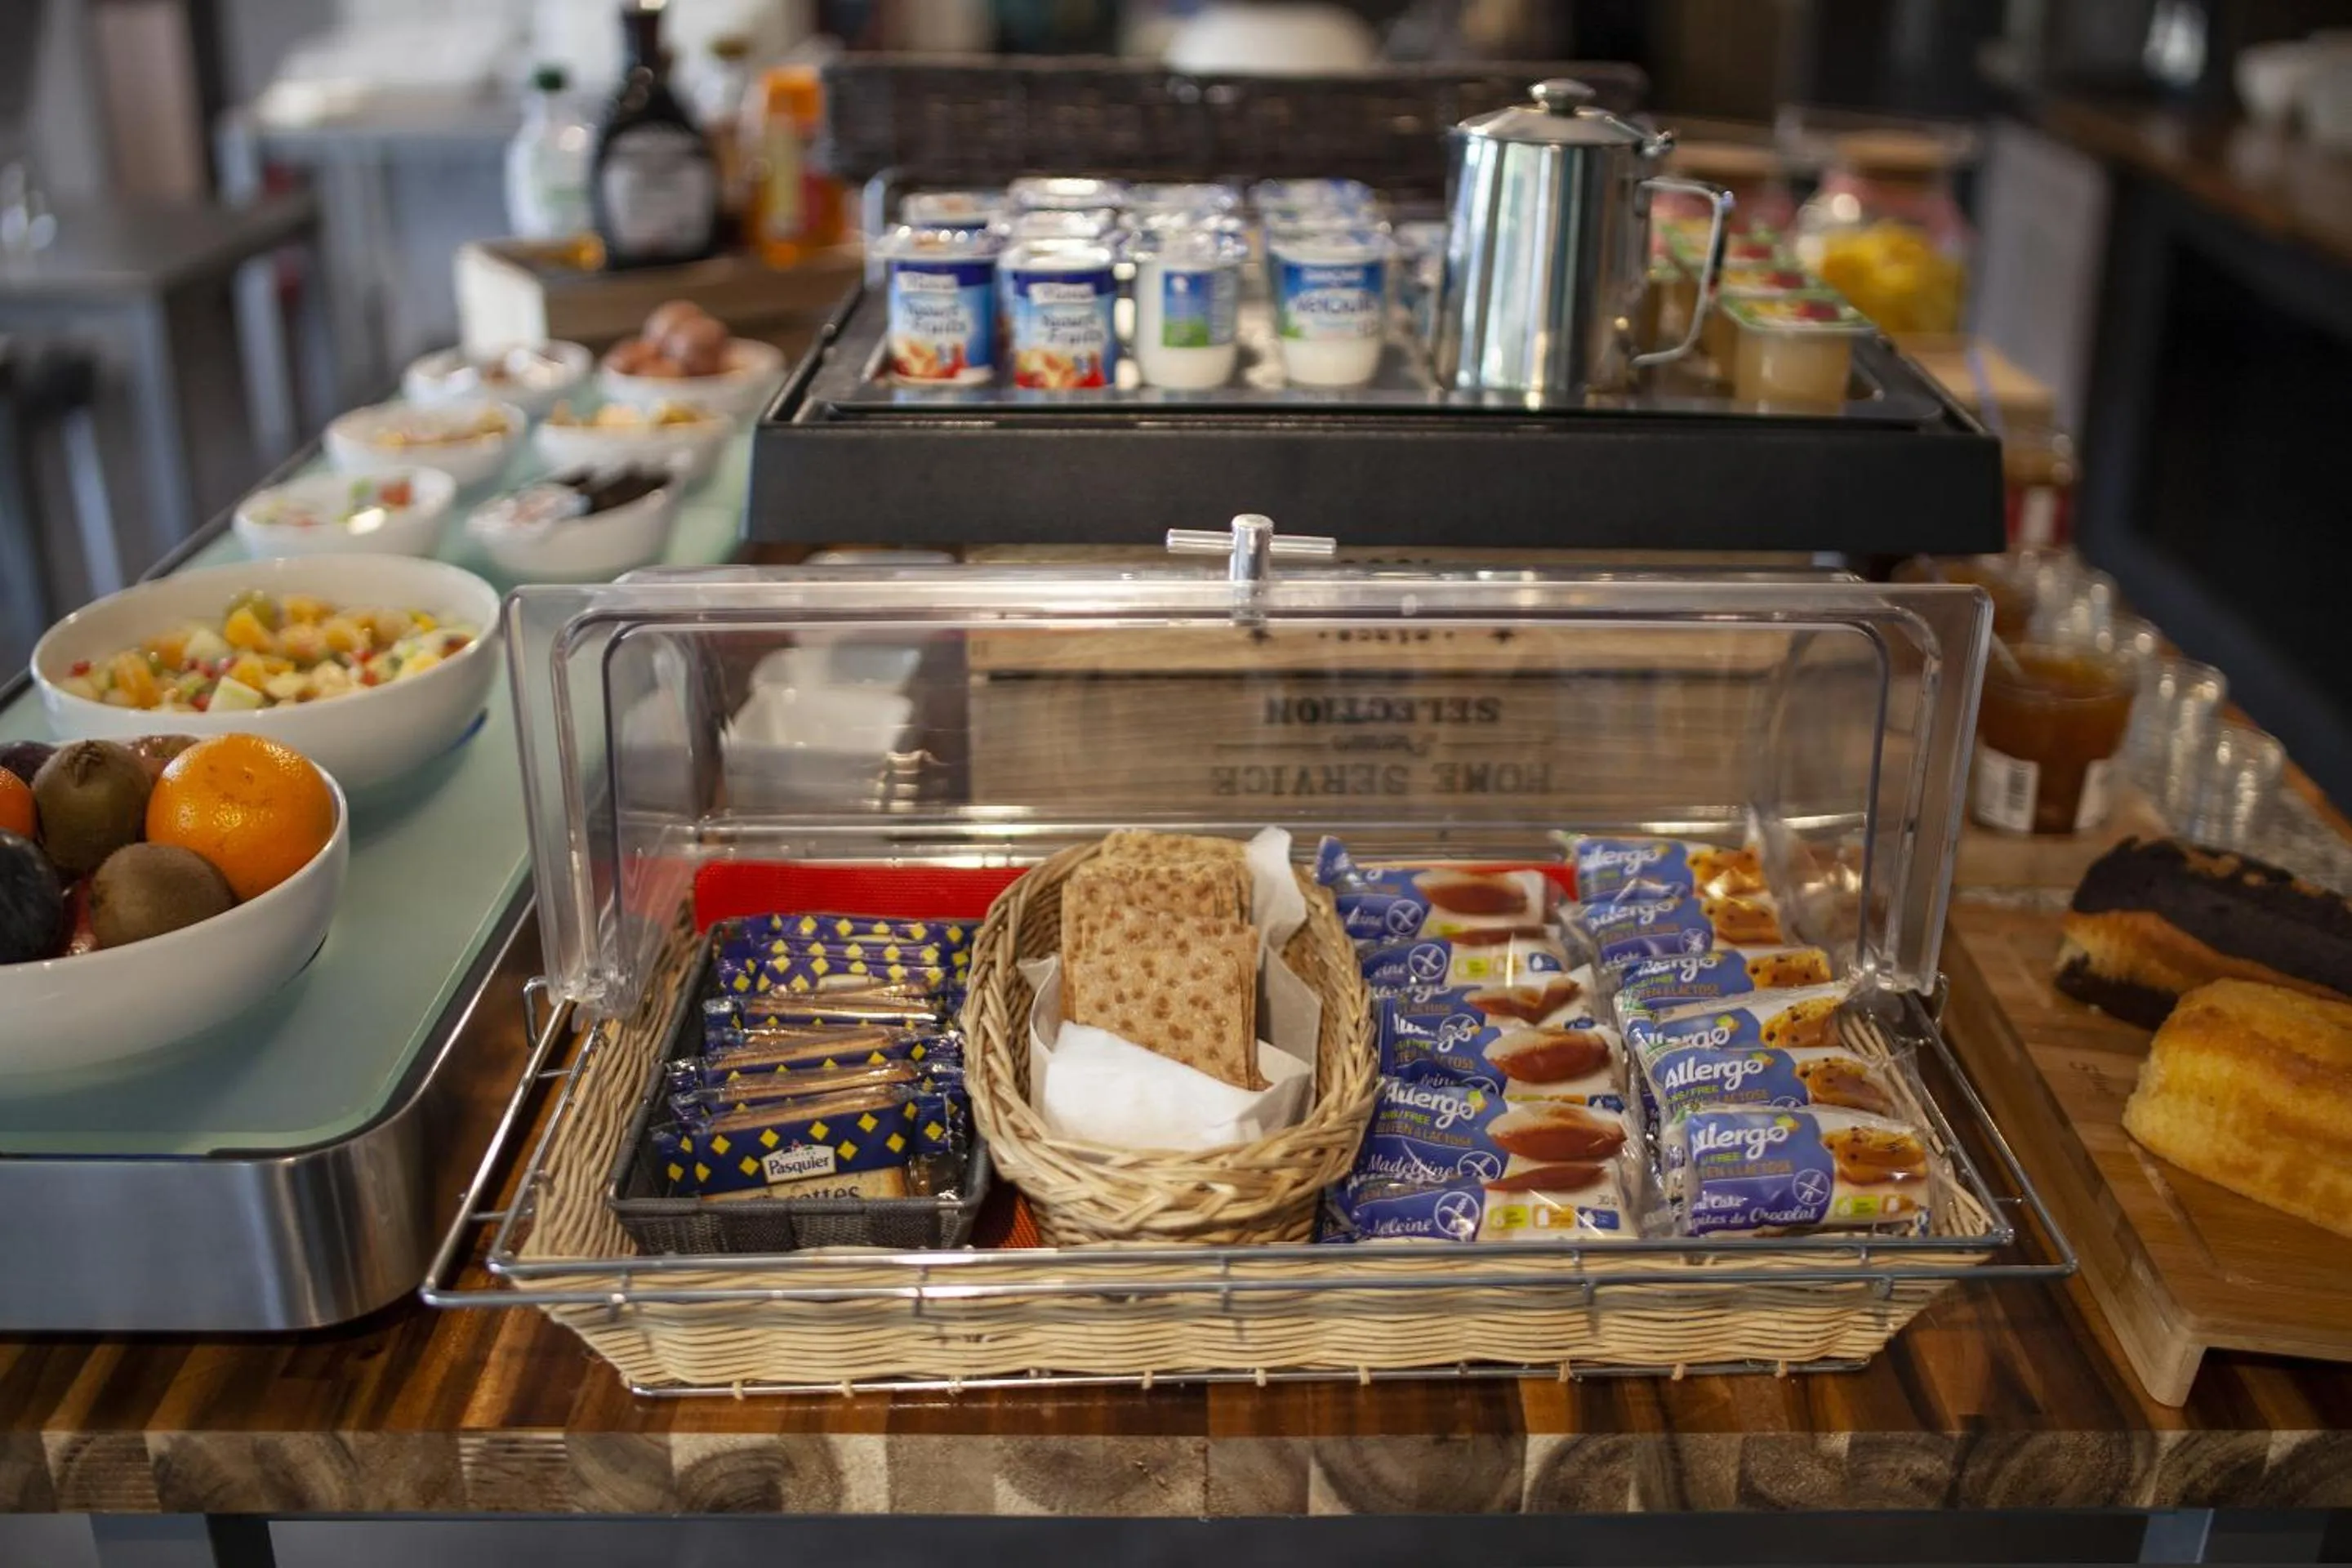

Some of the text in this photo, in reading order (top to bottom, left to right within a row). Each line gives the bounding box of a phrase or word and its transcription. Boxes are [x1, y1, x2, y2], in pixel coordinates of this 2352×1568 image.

[1264, 697, 1502, 725] SELECTION
[1210, 762, 1552, 796] HOME SERVICE
[1665, 1056, 1764, 1092] Allergo
[1385, 1080, 1475, 1129] Allergo
[768, 1156, 829, 1175] Pasquier
